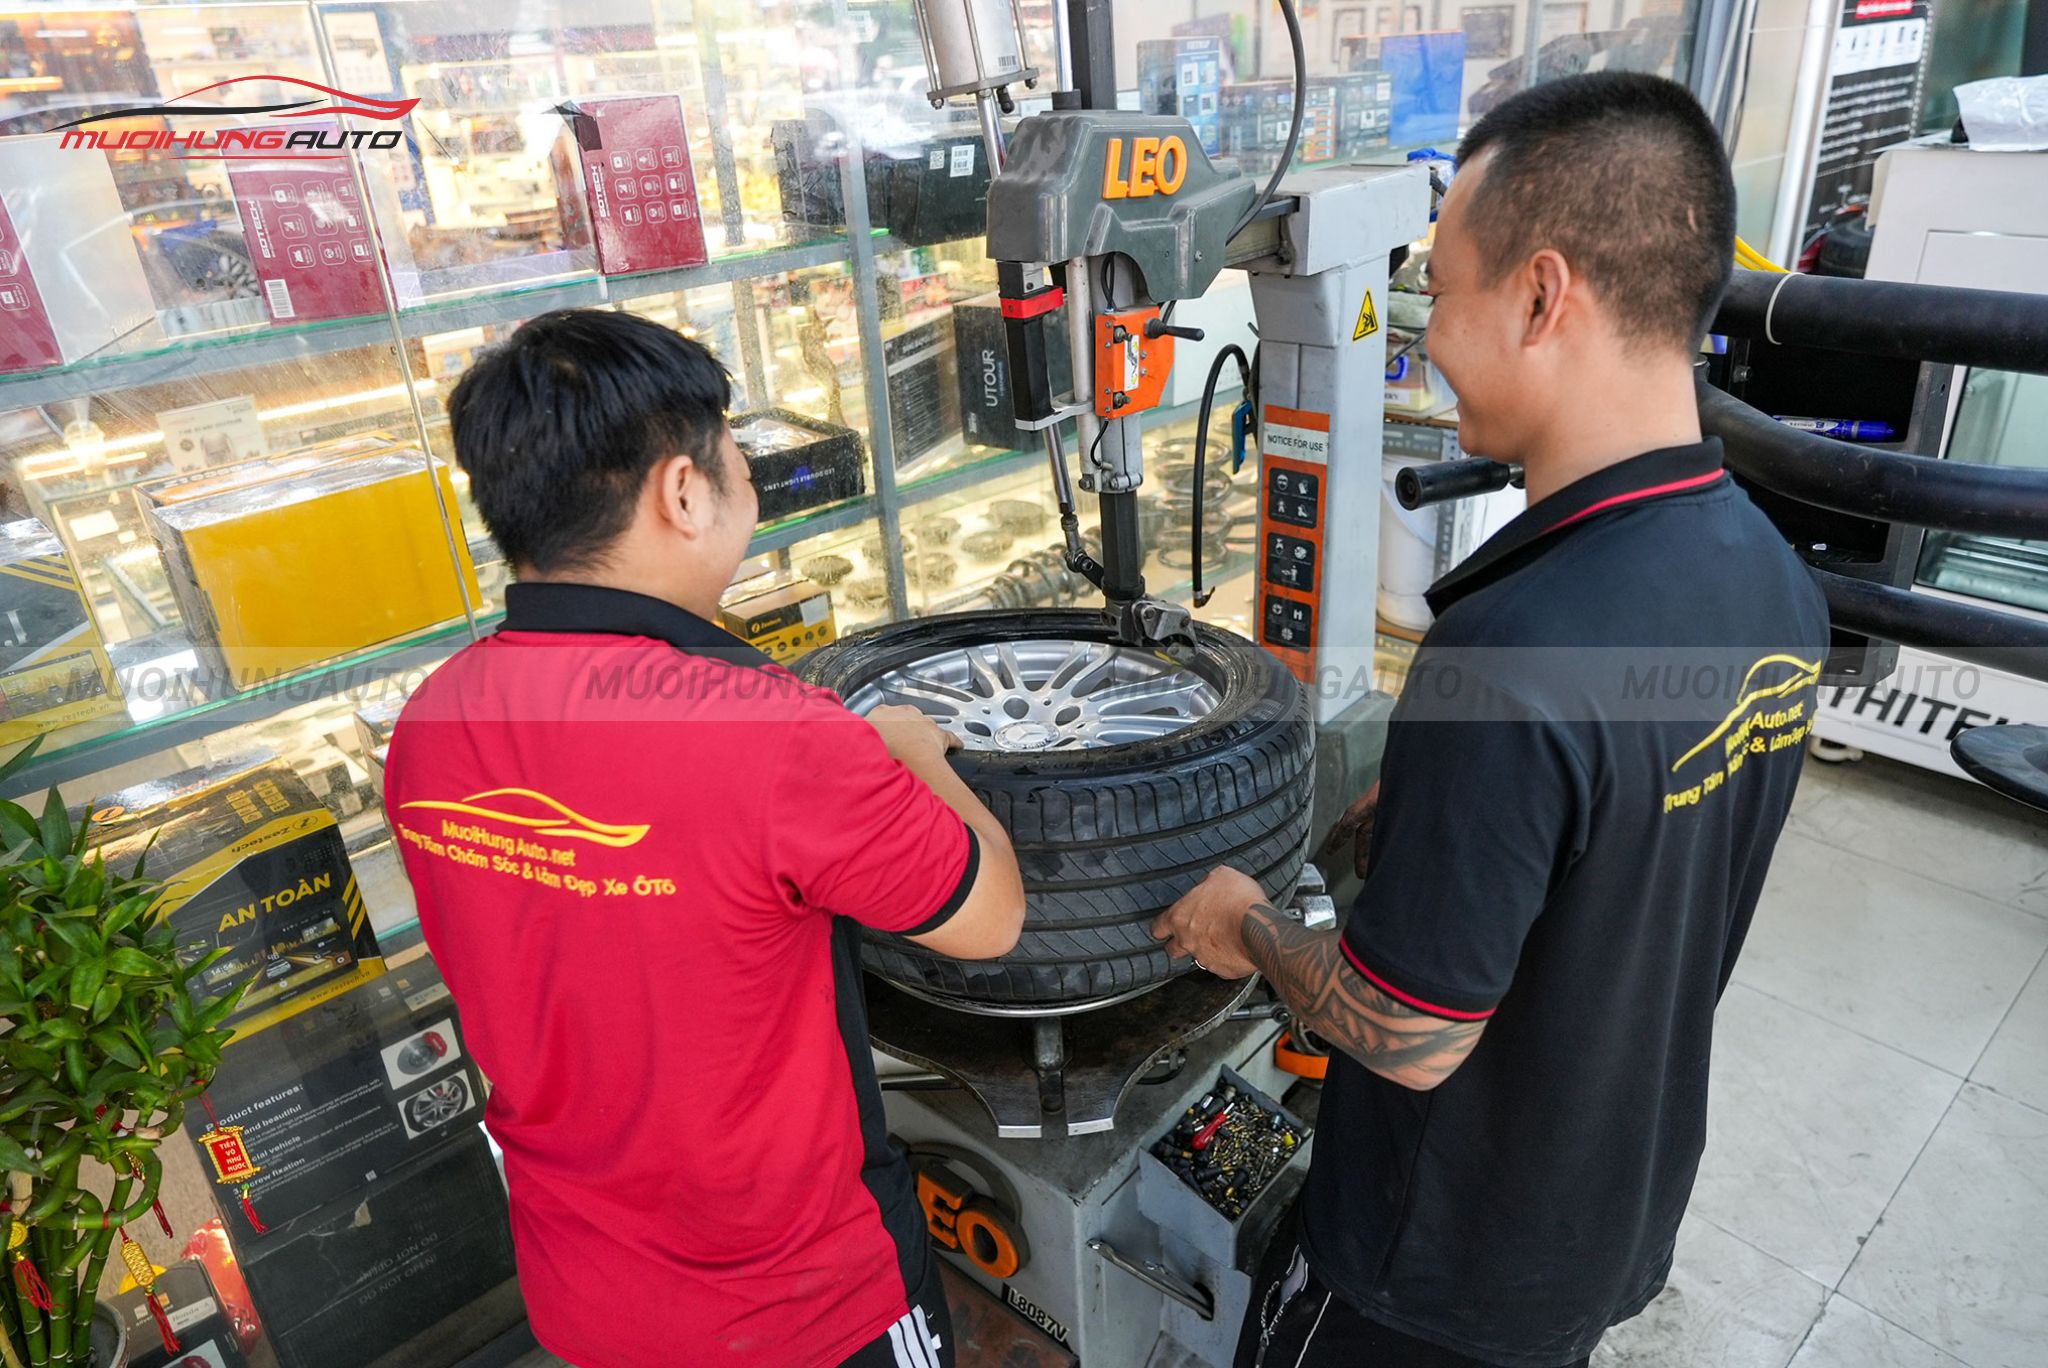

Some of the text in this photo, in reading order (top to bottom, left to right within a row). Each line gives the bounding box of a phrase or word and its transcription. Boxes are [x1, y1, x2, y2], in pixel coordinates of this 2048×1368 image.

[1102, 134, 1188, 199] LEO
[982, 349, 999, 408] UTOUR
[1267, 434, 1324, 452] NOTICE FOR USE
[1750, 736, 1766, 753] &
[442, 819, 515, 856] MuoiHung
[492, 855, 520, 875] Sóc
[522, 862, 533, 879] &
[563, 874, 597, 898] Đẹp
[603, 877, 628, 896] Xe
[218, 872, 332, 933] AN TOÀN
[253, 1084, 304, 1112] features:
[244, 1103, 303, 1135] and beautiful
[251, 1135, 301, 1163] cial vehicle
[246, 1173, 272, 1188] crew
[272, 1157, 306, 1176] fixation
[918, 1170, 1019, 1278] EO
